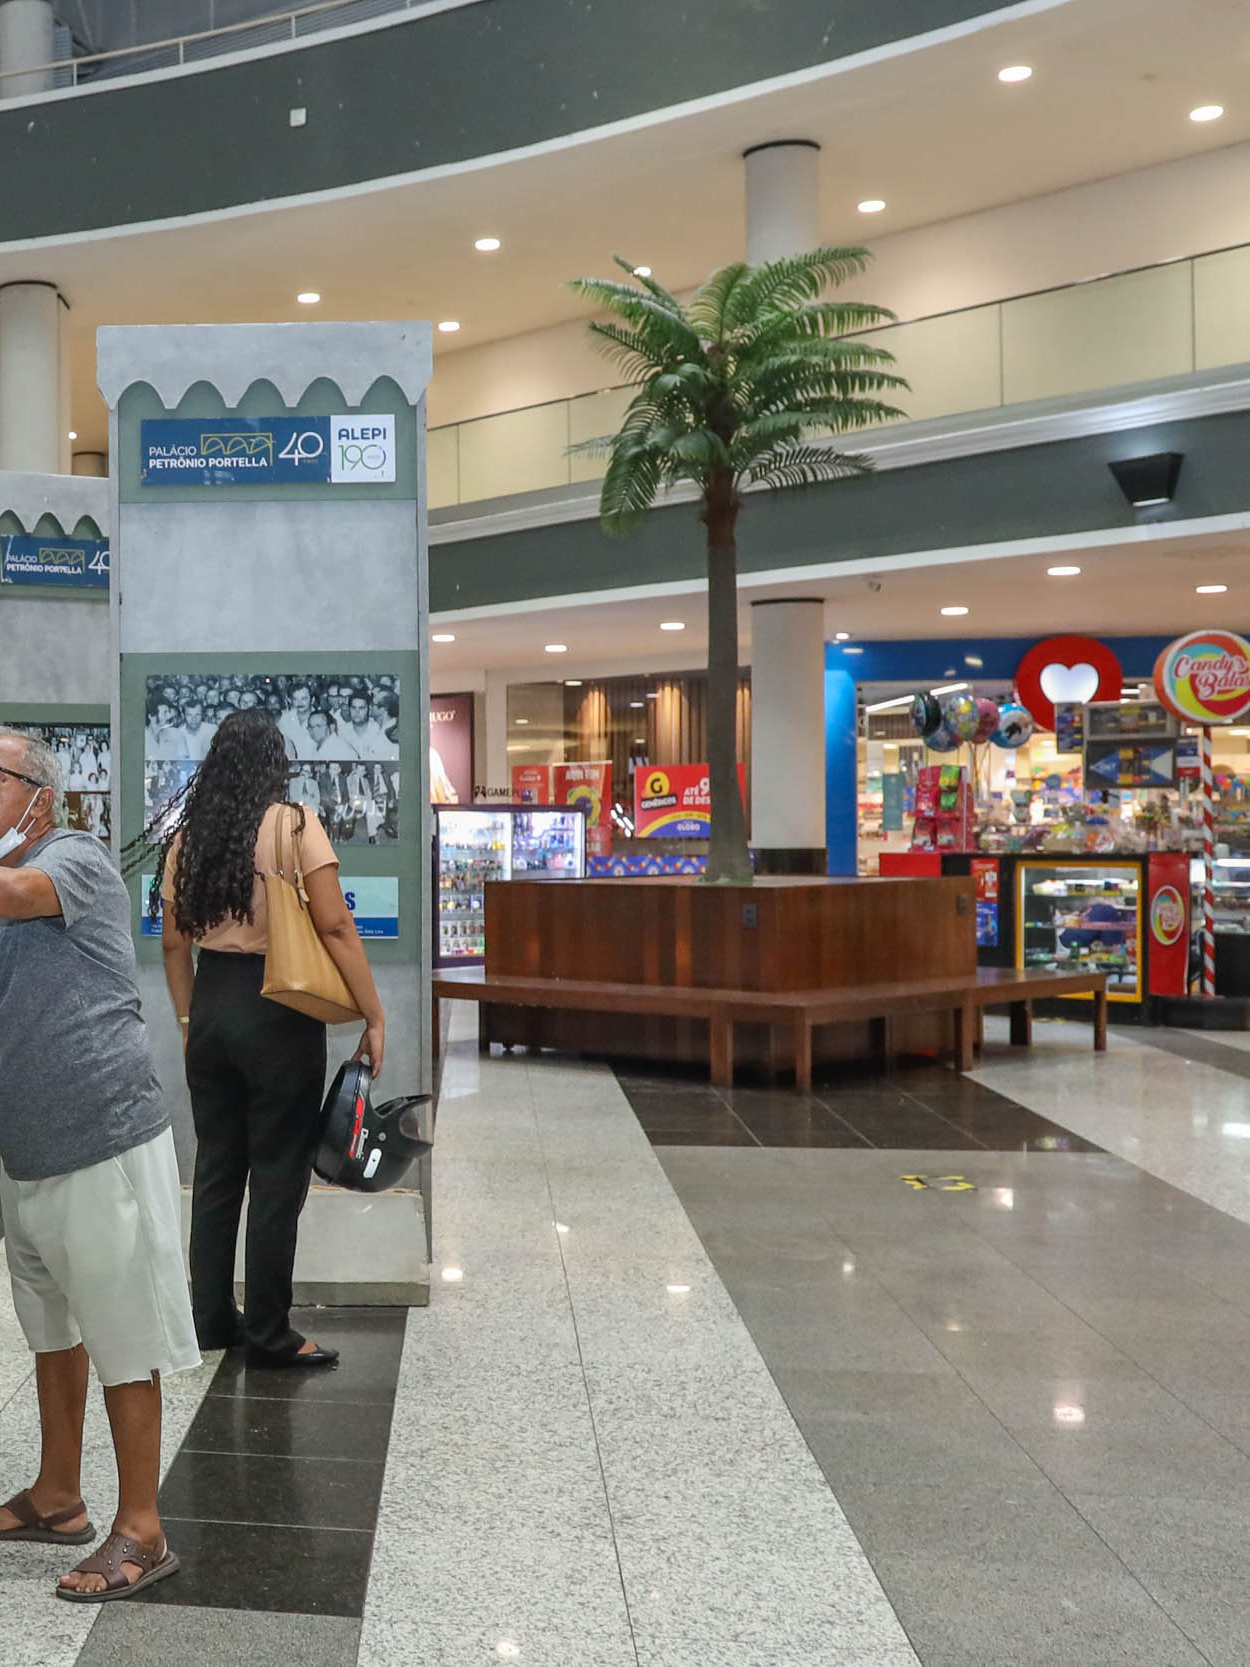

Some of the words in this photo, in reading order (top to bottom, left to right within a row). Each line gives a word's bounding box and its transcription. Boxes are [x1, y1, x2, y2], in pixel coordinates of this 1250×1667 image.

[338, 427, 386, 440] ALEPI
[149, 444, 197, 456] PALÁCIO
[278, 431, 324, 466] 40
[149, 457, 206, 469] PETRÔNIO
[209, 457, 268, 467] PORTELLA
[337, 444, 386, 471] 190
[6, 554, 38, 563] PALÁCIO
[6, 563, 44, 572] PETRÔNIO
[44, 564, 82, 574] PORTELLA
